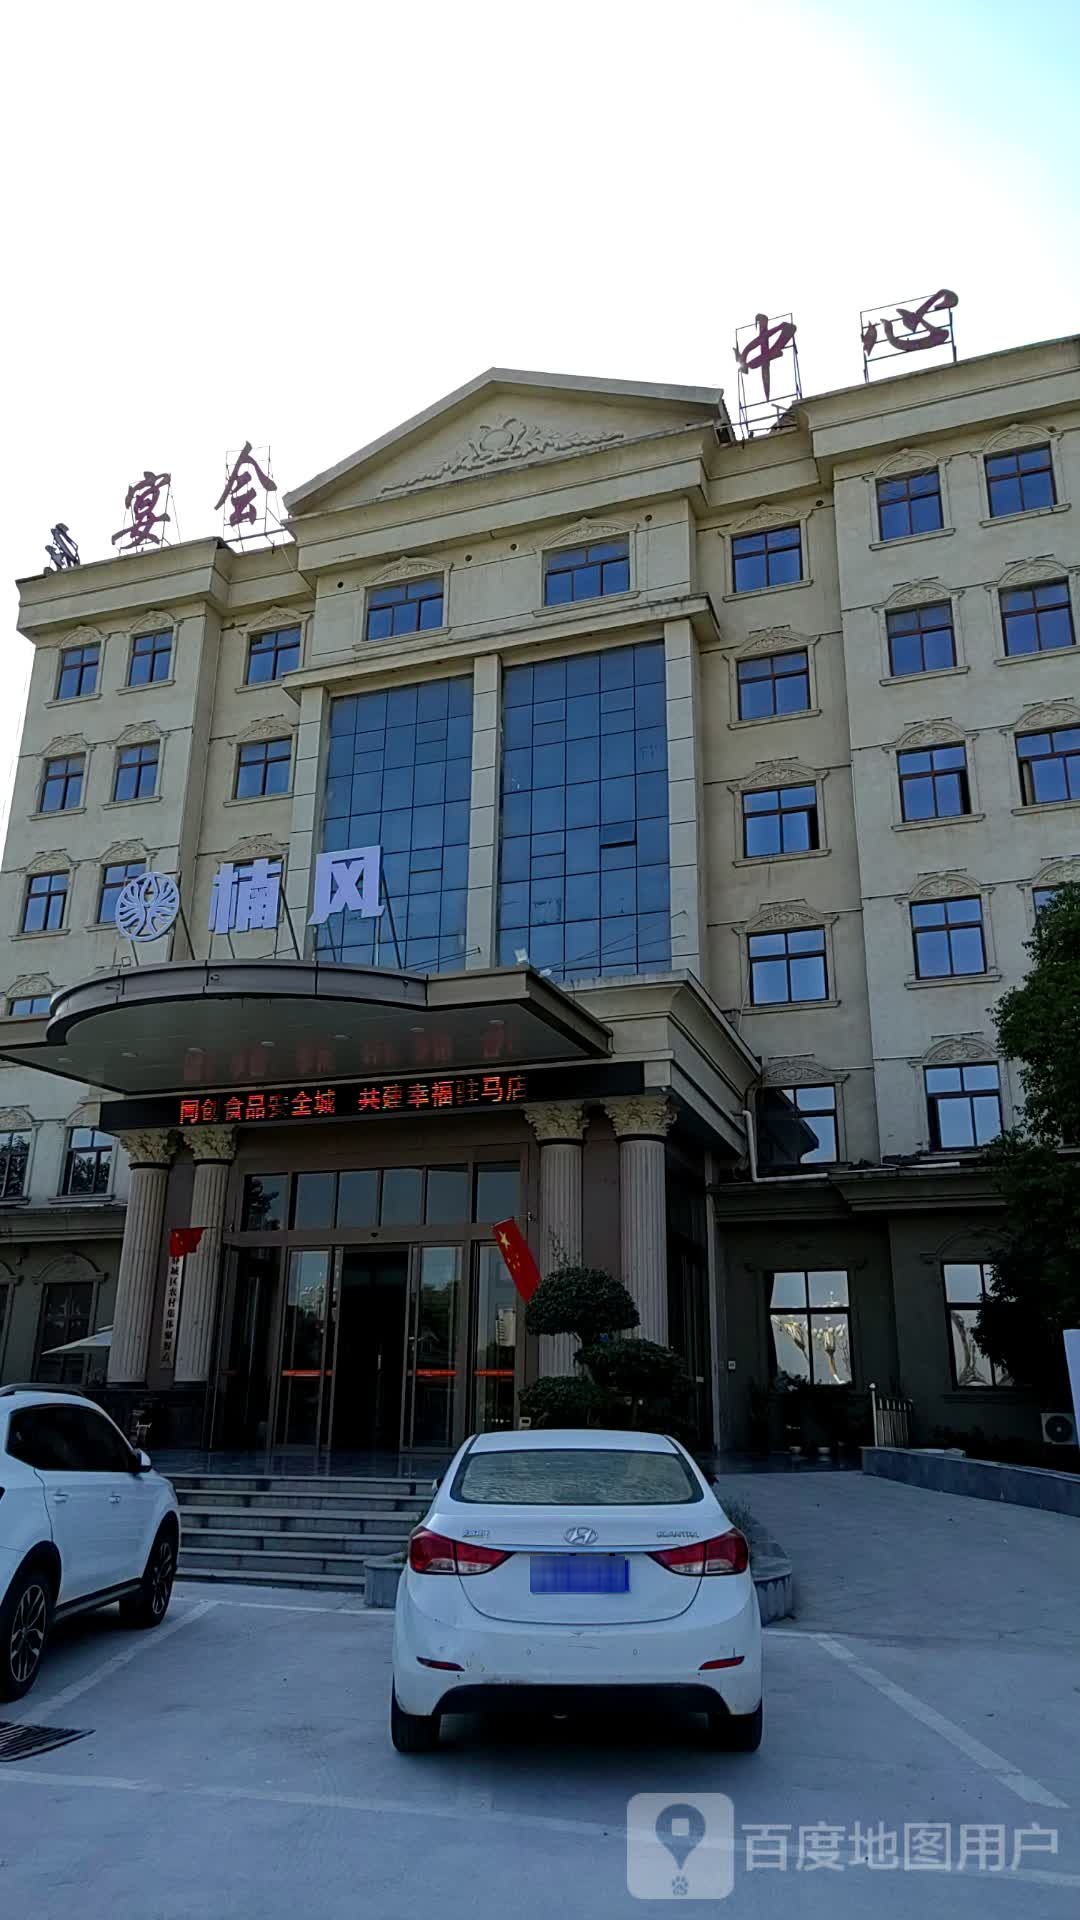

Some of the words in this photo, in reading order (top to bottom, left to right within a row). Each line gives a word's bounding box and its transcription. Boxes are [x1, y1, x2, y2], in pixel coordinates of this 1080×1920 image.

[358, 1076, 526, 1111] 共建幸福驻马店
